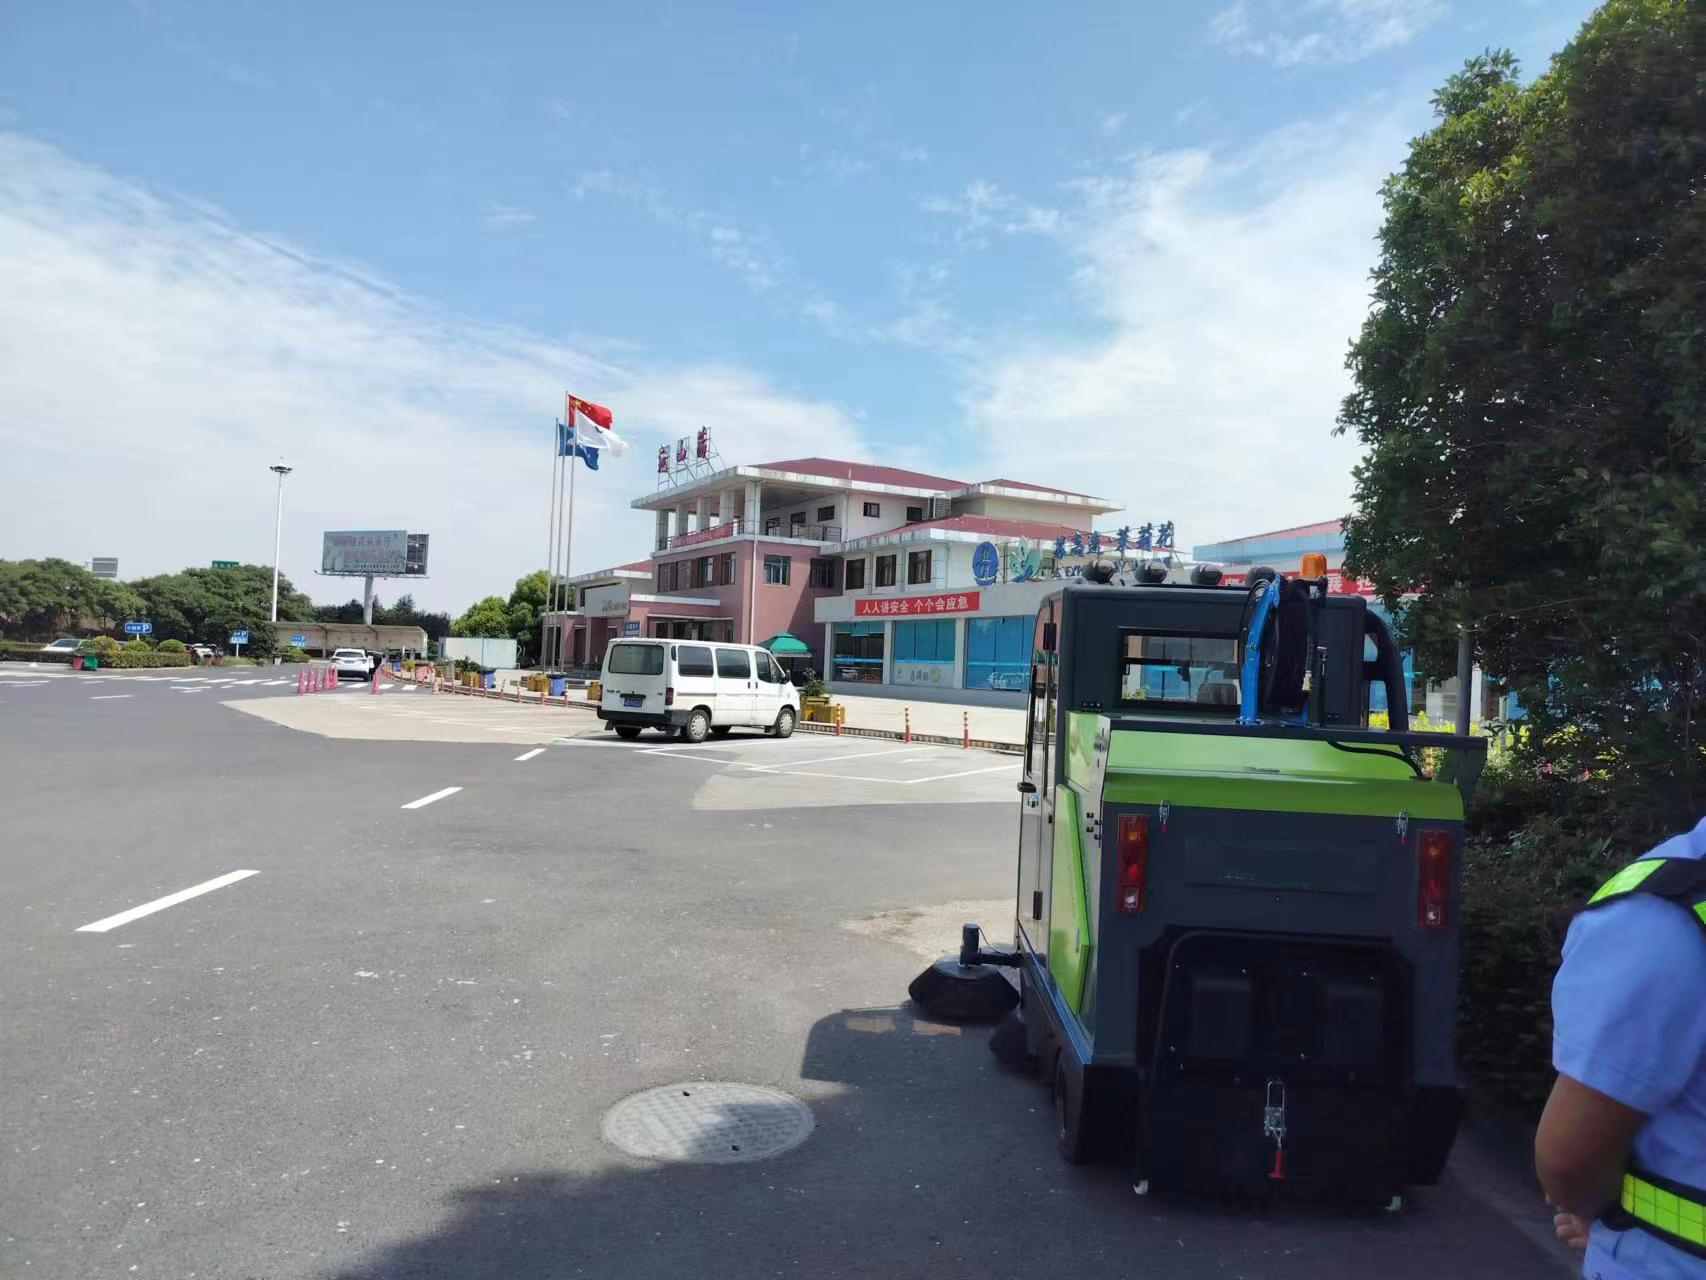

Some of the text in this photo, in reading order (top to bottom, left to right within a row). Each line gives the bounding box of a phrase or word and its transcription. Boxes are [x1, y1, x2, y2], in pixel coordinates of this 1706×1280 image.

[862, 596, 969, 614] 人人讲安全 个个会应急
